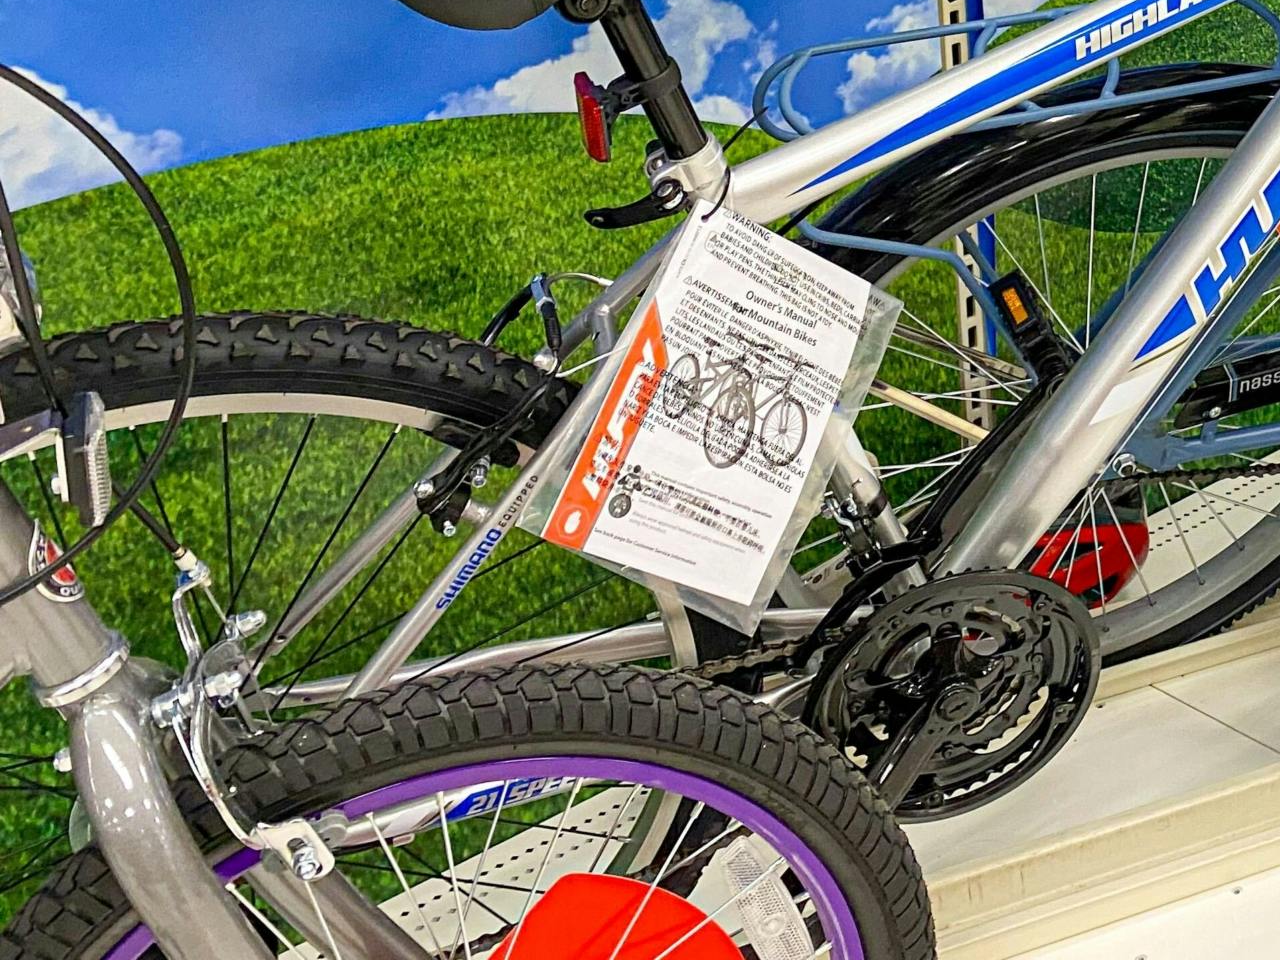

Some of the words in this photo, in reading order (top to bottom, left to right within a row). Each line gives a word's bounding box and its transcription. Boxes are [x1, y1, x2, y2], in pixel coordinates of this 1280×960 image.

[723, 222, 735, 233] TO
[731, 227, 753, 244] AVOID
[728, 211, 774, 243] WARNING:
[718, 230, 742, 249] BABIES
[738, 242, 754, 256] AND
[797, 279, 812, 293] USE
[722, 244, 740, 259] PLAY
[709, 248, 725, 262] AND
[721, 255, 751, 277] PREVENT
[777, 289, 793, 303] THIS
[789, 297, 804, 310] BAG
[799, 303, 808, 313] IS
[804, 307, 820, 320] NOT
[727, 313, 753, 333] DANGER
[743, 286, 785, 318] Owner's
[781, 304, 819, 333] Manual
[745, 306, 793, 341] Mountain
[791, 327, 819, 350] Bikes
[652, 414, 672, 430] BOCA
[742, 461, 760, 476] ESTA
[756, 469, 777, 486] BOLSA
[774, 479, 786, 490] NO
[783, 484, 793, 494] ES
[435, 528, 502, 609] SHIMANO
[466, 791, 499, 816] 21
[505, 776, 577, 804] SPEE
